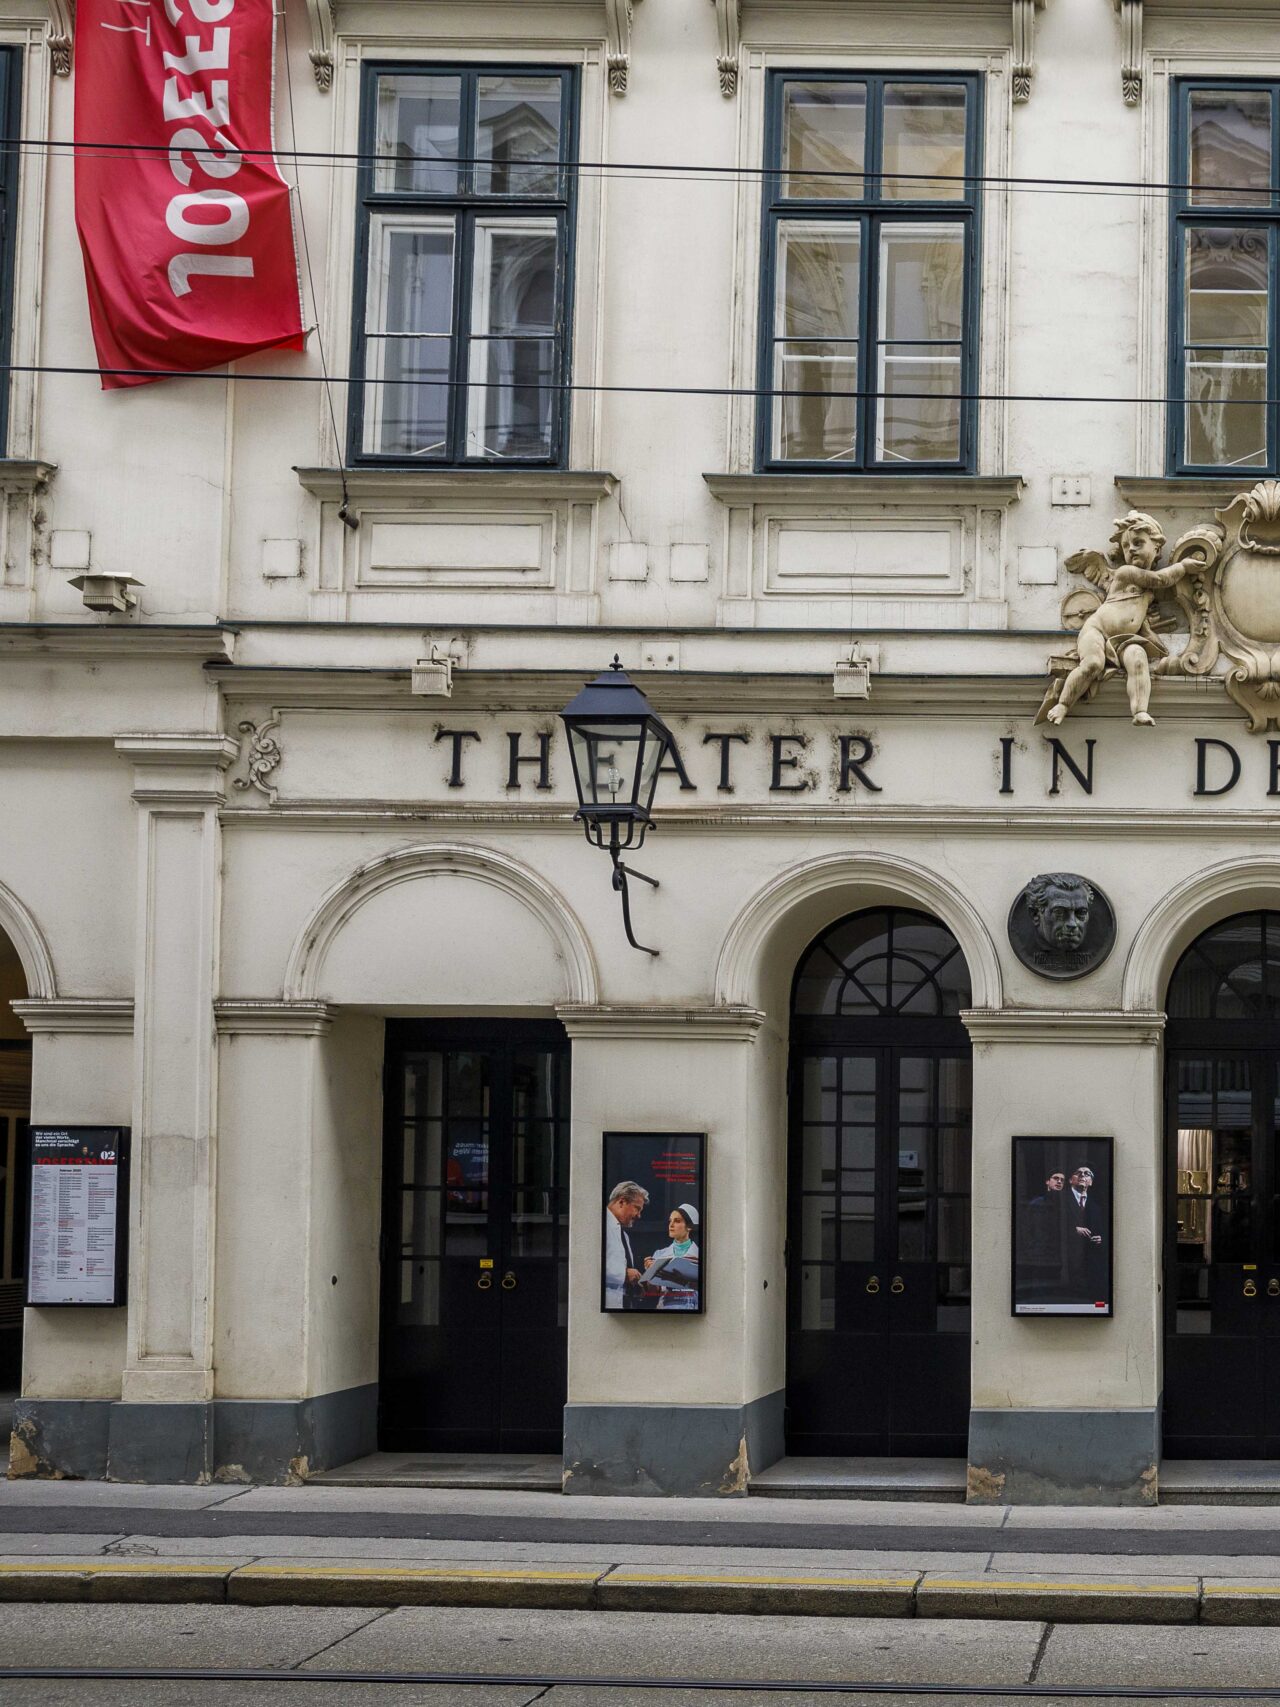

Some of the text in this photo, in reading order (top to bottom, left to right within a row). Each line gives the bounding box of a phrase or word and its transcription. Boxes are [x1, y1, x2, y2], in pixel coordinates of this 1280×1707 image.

[434, 730, 883, 791] THEATER
[999, 737, 1097, 795] IN
[100, 1150, 116, 1160] 02
